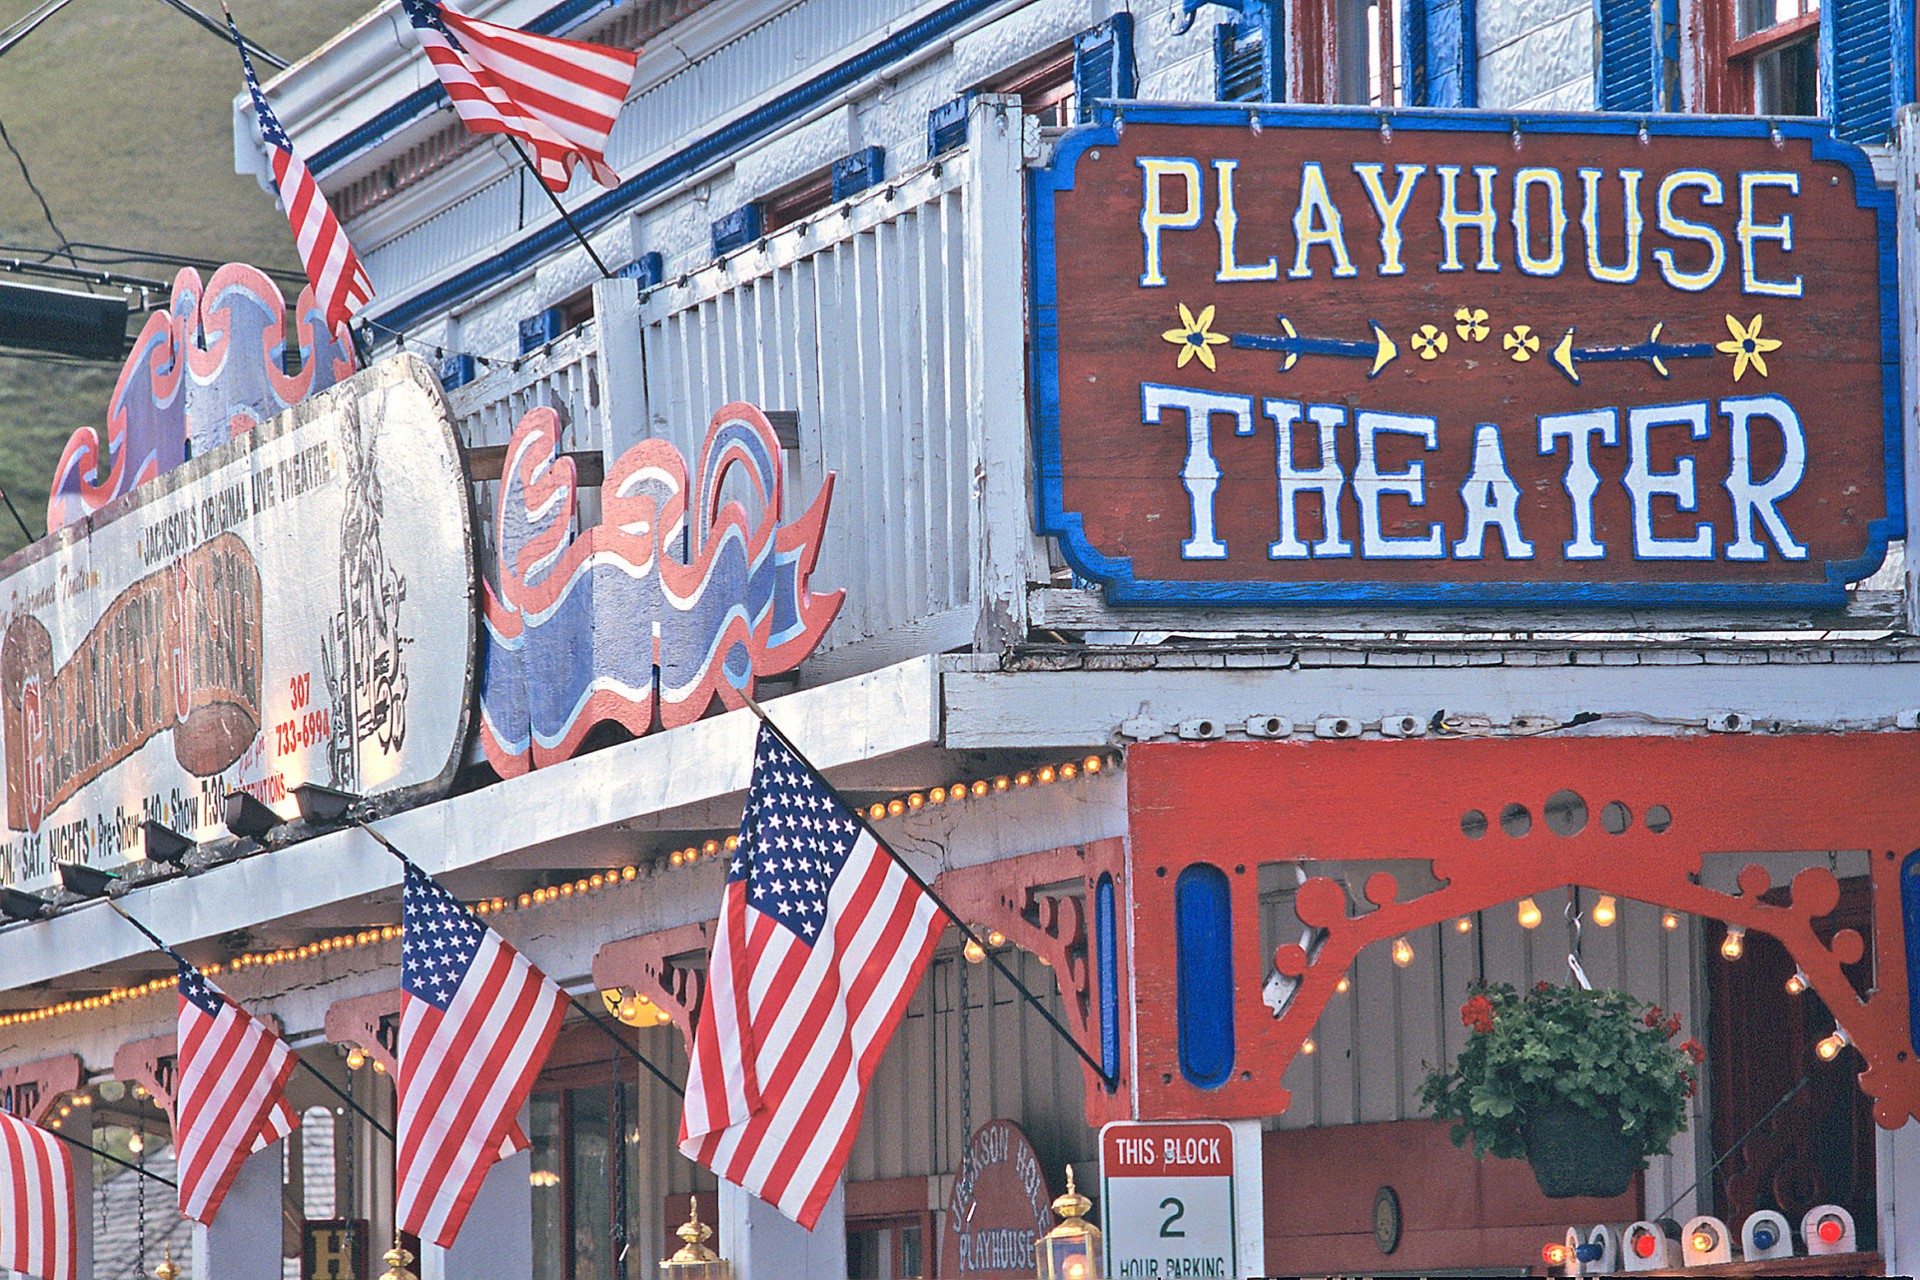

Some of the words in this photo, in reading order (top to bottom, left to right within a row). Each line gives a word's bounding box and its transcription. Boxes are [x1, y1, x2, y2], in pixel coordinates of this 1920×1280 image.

[1136, 156, 1804, 298] PLAYHOUSE
[1140, 382, 1808, 561] THEATER
[144, 504, 197, 566] JACKSON'S
[201, 482, 249, 539] ORIGINAL
[251, 465, 275, 515] LIVE
[278, 440, 330, 502] THEATRE
[290, 672, 310, 711] 307
[275, 708, 330, 757] 733-6994
[22, 834, 44, 881] SAT.
[50, 818, 90, 873] NIGHTS
[98, 806, 139, 857] Pre-Show
[171, 787, 198, 832] Show
[201, 775, 226, 826] 7:30
[1116, 1138, 1154, 1164] THIS
[1164, 1138, 1220, 1164] BLOCK
[1159, 1197, 1185, 1238] 2
[959, 1226, 1036, 1272] PLAYHOUSE
[1120, 1258, 1158, 1278] HOUR
[1166, 1257, 1225, 1278] PARKING
